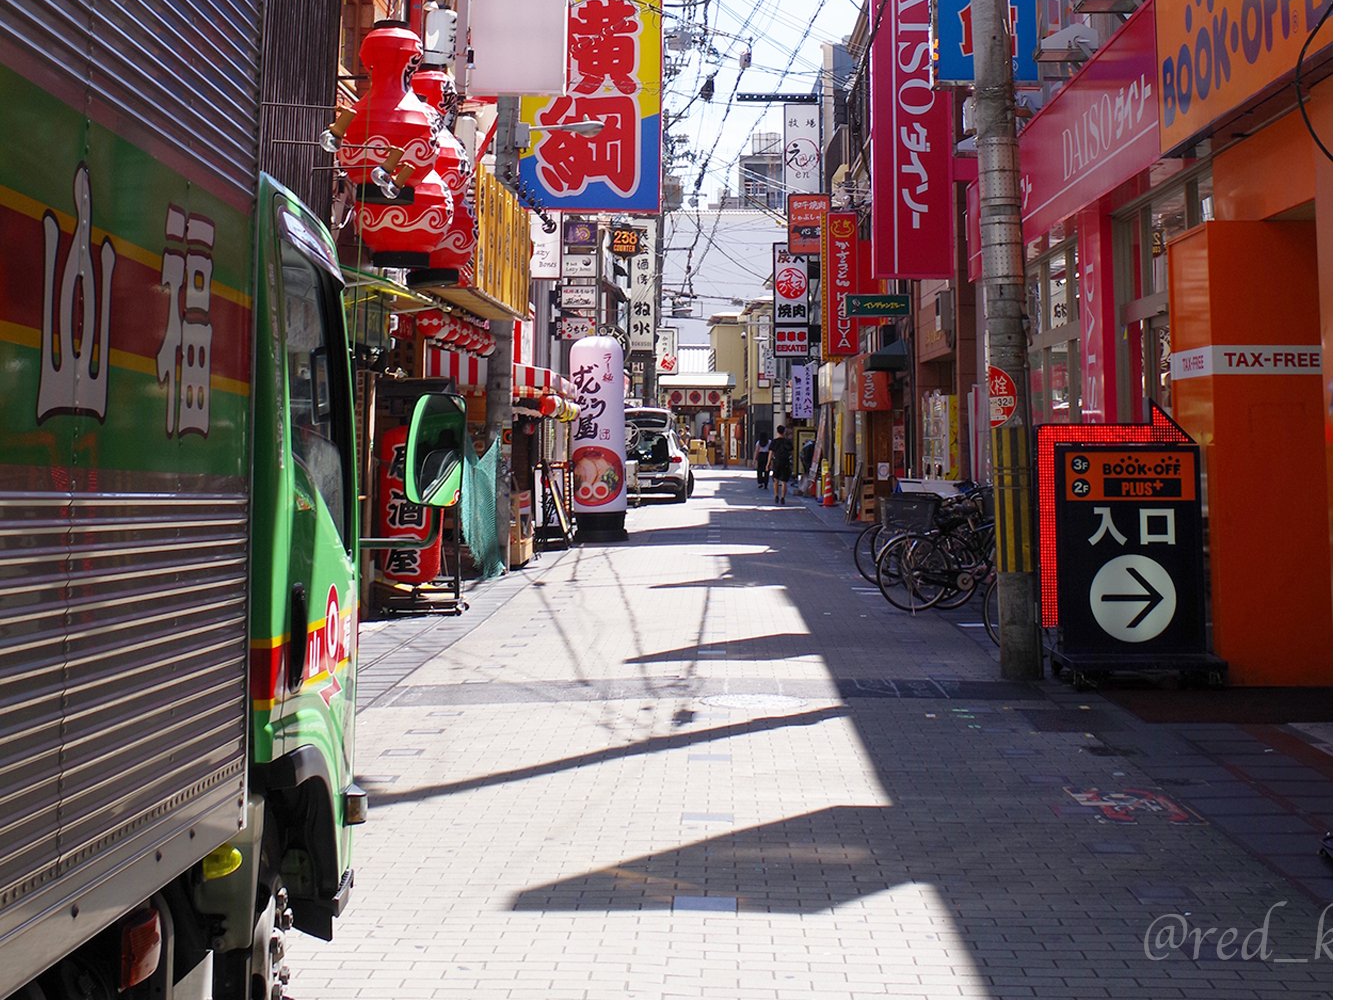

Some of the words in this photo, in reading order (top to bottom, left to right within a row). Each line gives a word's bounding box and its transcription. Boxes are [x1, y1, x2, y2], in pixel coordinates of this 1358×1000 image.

[1062, 93, 1111, 181] DAISO
[1114, 74, 1151, 141] ダイソー
[901, 122, 931, 229] ダイソー
[778, 304, 806, 318] 焼肉
[1182, 354, 1205, 371] TAX-FREE
[1223, 352, 1321, 368] TAX-FREE
[1073, 458, 1088, 470] 3F
[1074, 481, 1089, 493] 2F
[1088, 507, 1176, 546] 入口
